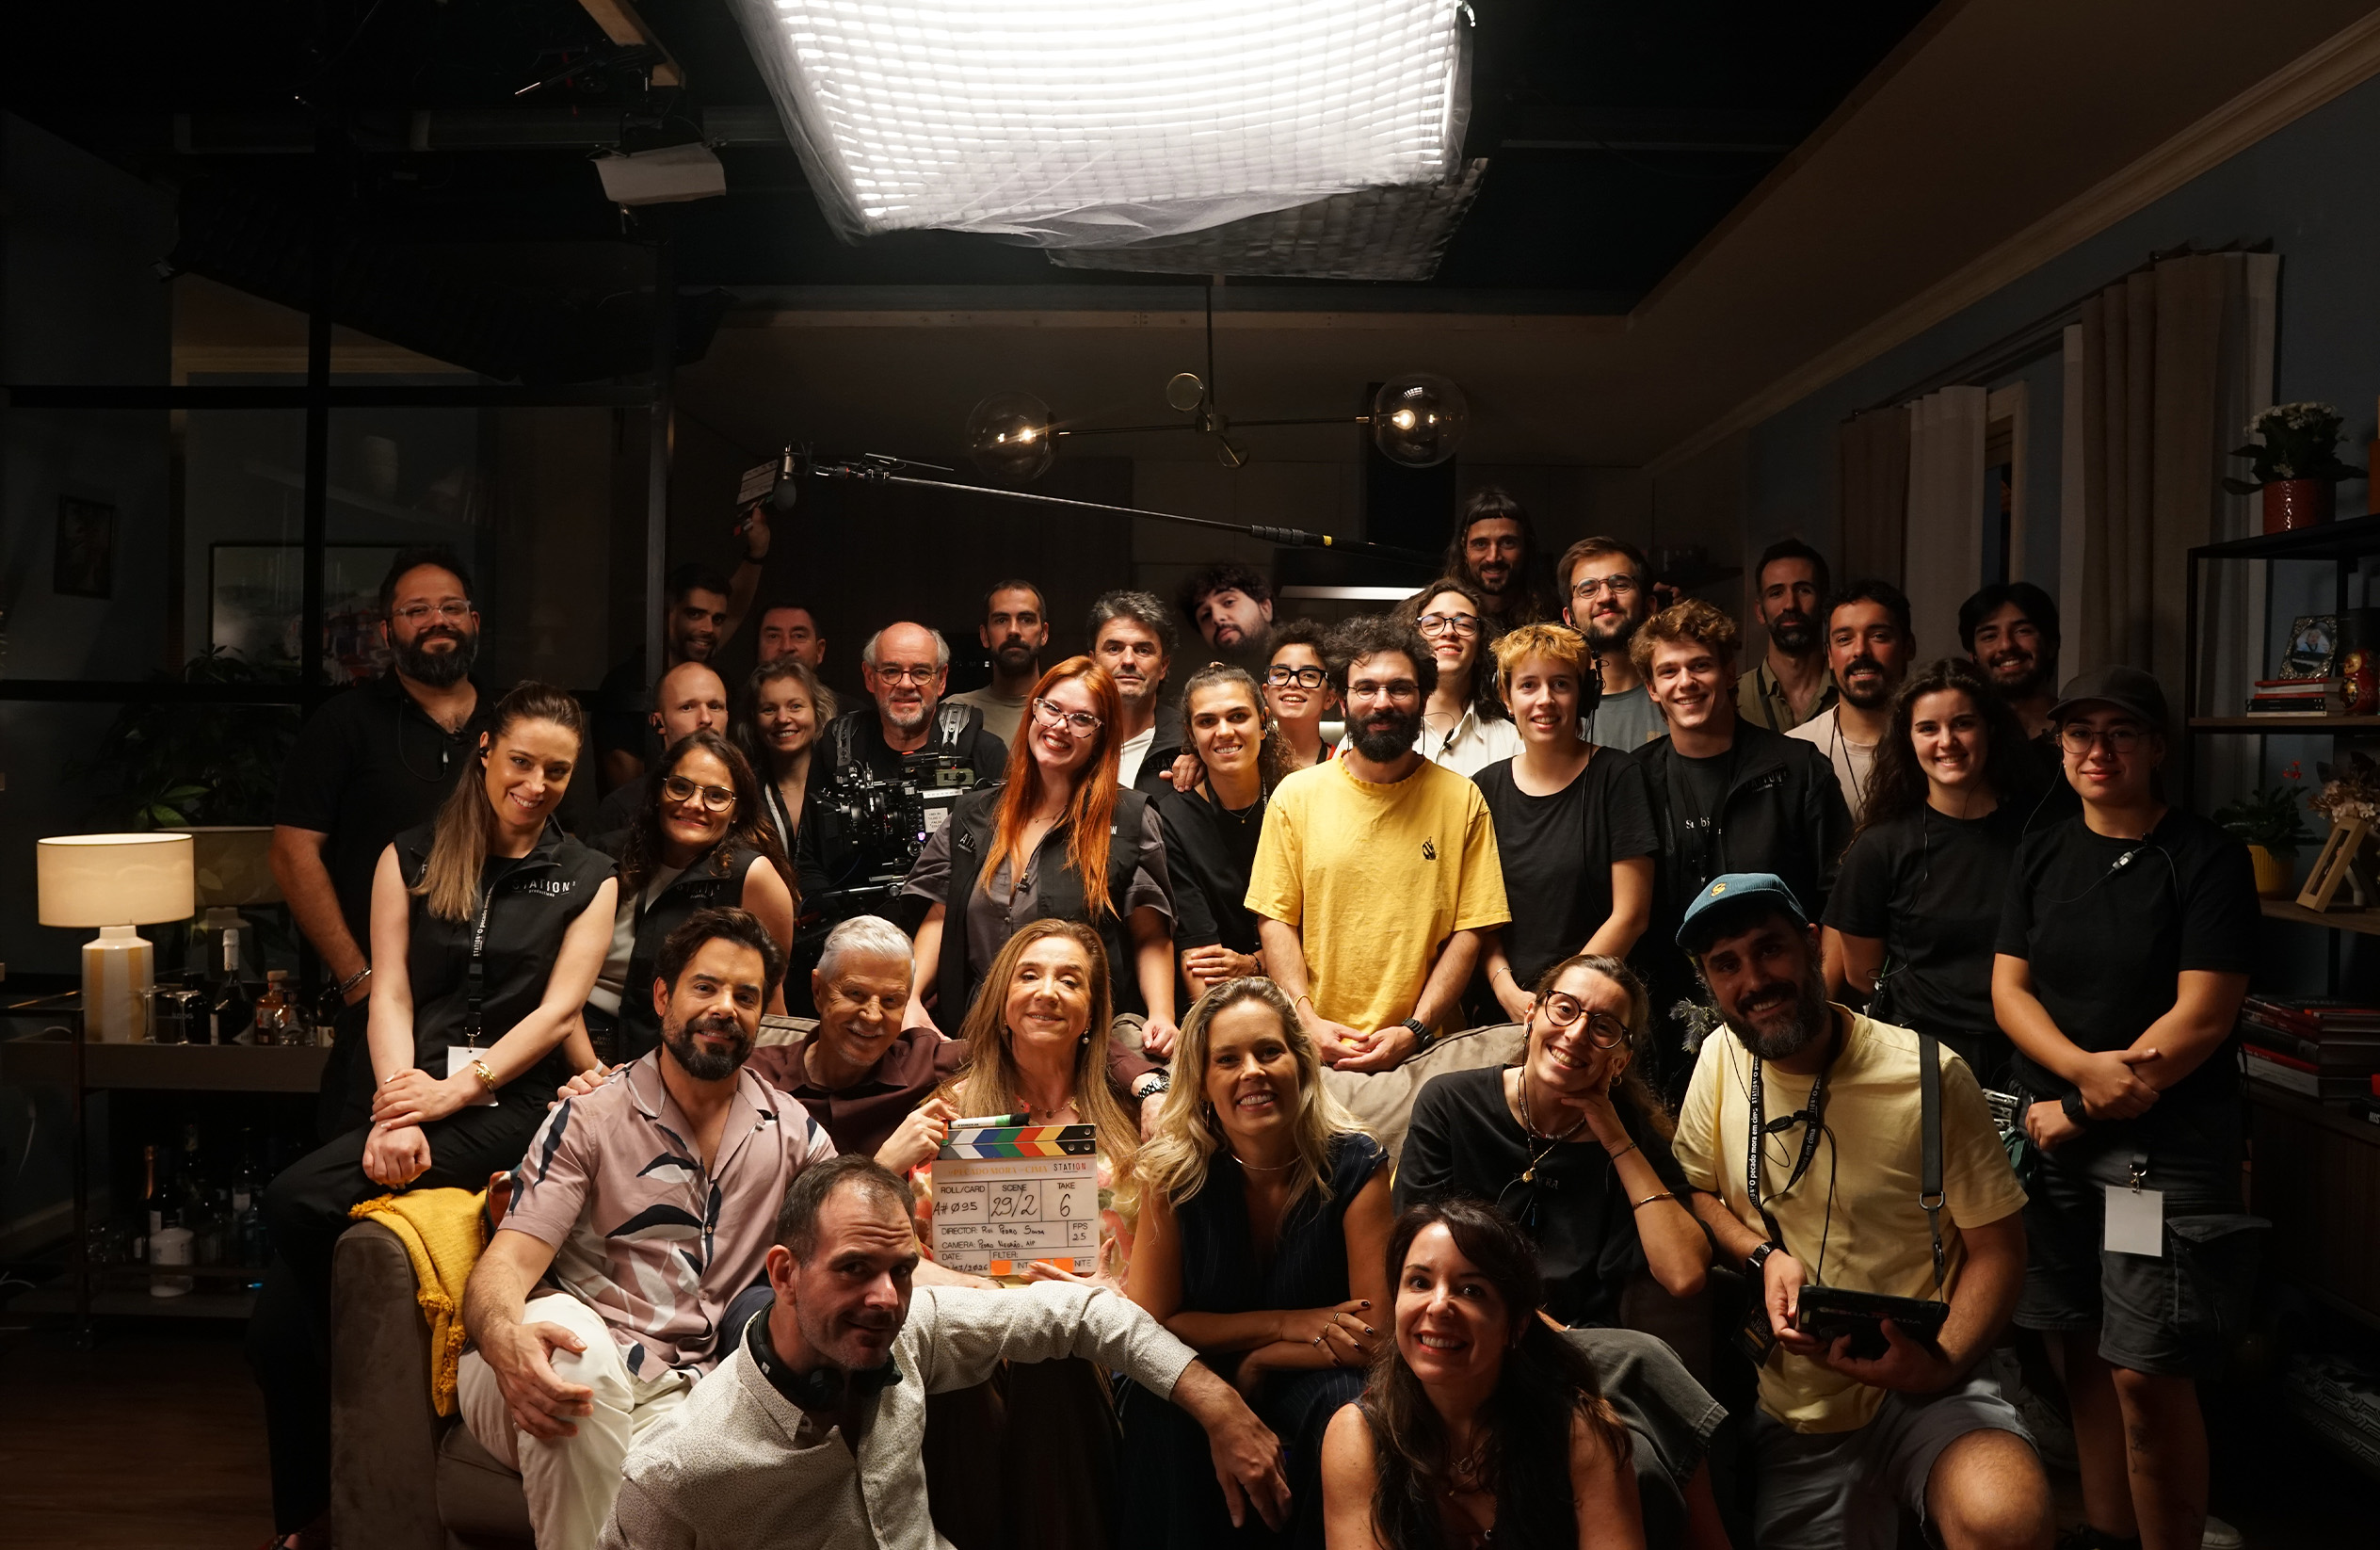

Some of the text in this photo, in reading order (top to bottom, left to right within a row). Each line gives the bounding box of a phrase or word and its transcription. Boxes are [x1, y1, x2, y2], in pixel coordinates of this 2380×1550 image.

[1752, 1124, 1758, 1136] em
[1053, 1162, 1086, 1171] STATION
[1749, 1154, 1758, 1179] pecado
[941, 1185, 985, 1194] ROLL/CARD
[1002, 1184, 1027, 1192] SCENE
[1060, 1193, 1070, 1218] 6
[941, 1226, 977, 1235] DIRECTOR:
[1071, 1232, 1086, 1241] 25
[941, 1241, 976, 1250] CAMERA:
[941, 1252, 962, 1261] DATE:
[992, 1251, 1019, 1259] FILTER:
